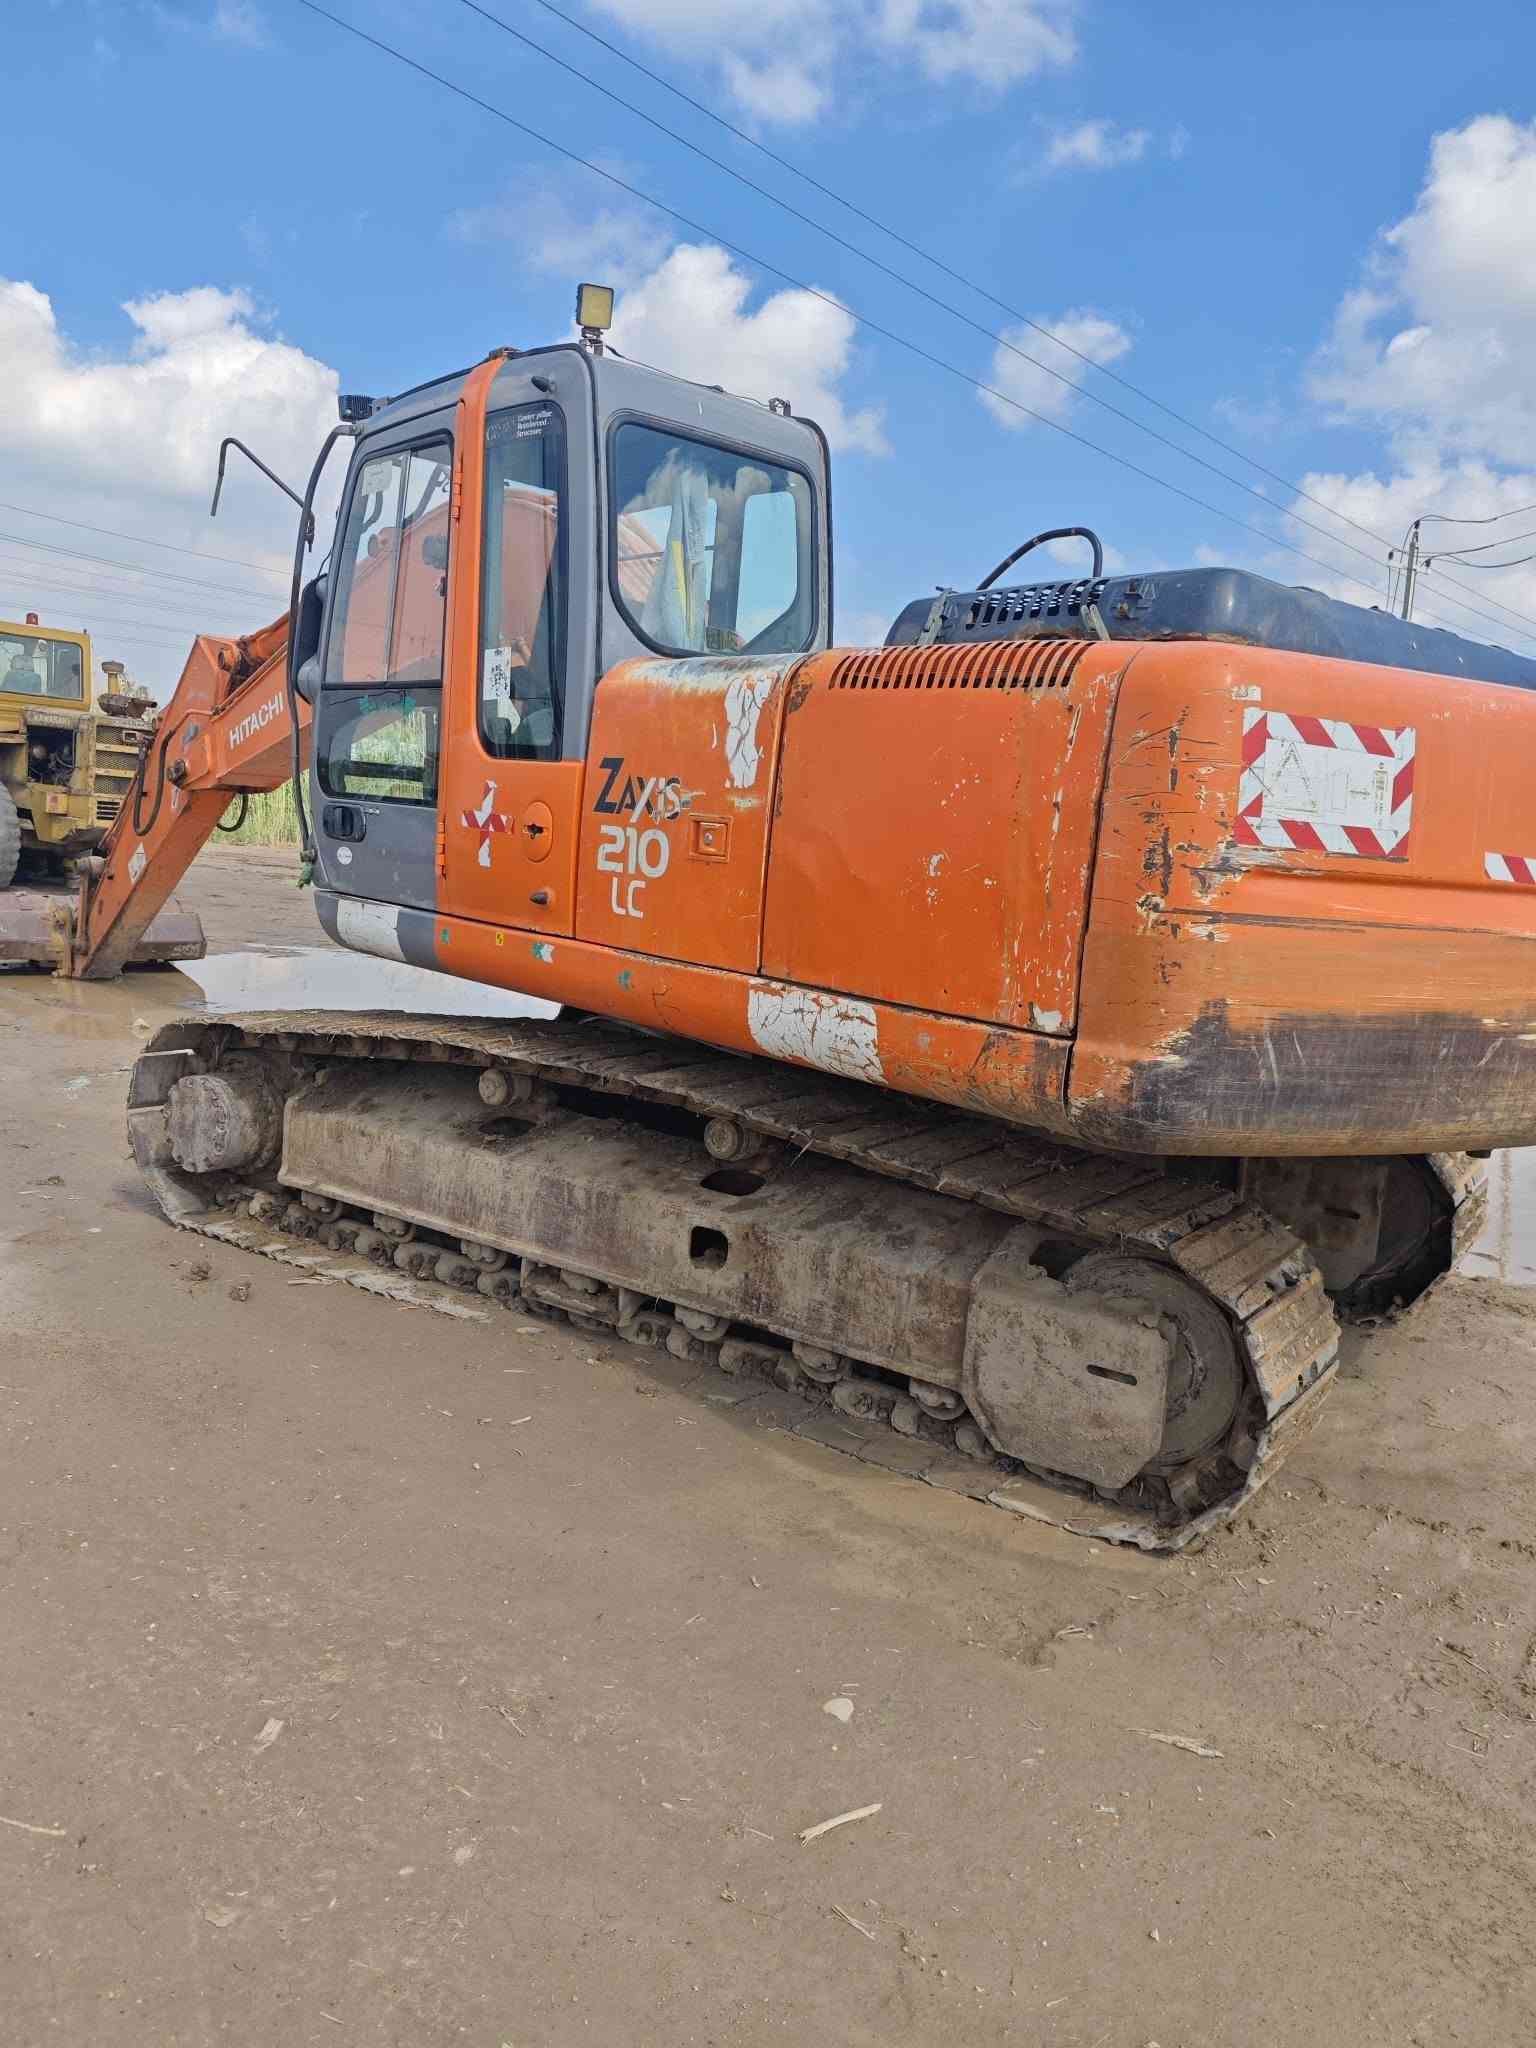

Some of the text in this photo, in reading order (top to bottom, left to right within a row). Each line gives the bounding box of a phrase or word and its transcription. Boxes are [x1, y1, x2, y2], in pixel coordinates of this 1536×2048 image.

[229, 691, 284, 750] HITACHI
[597, 824, 670, 878] 210
[611, 876, 647, 919] LC
